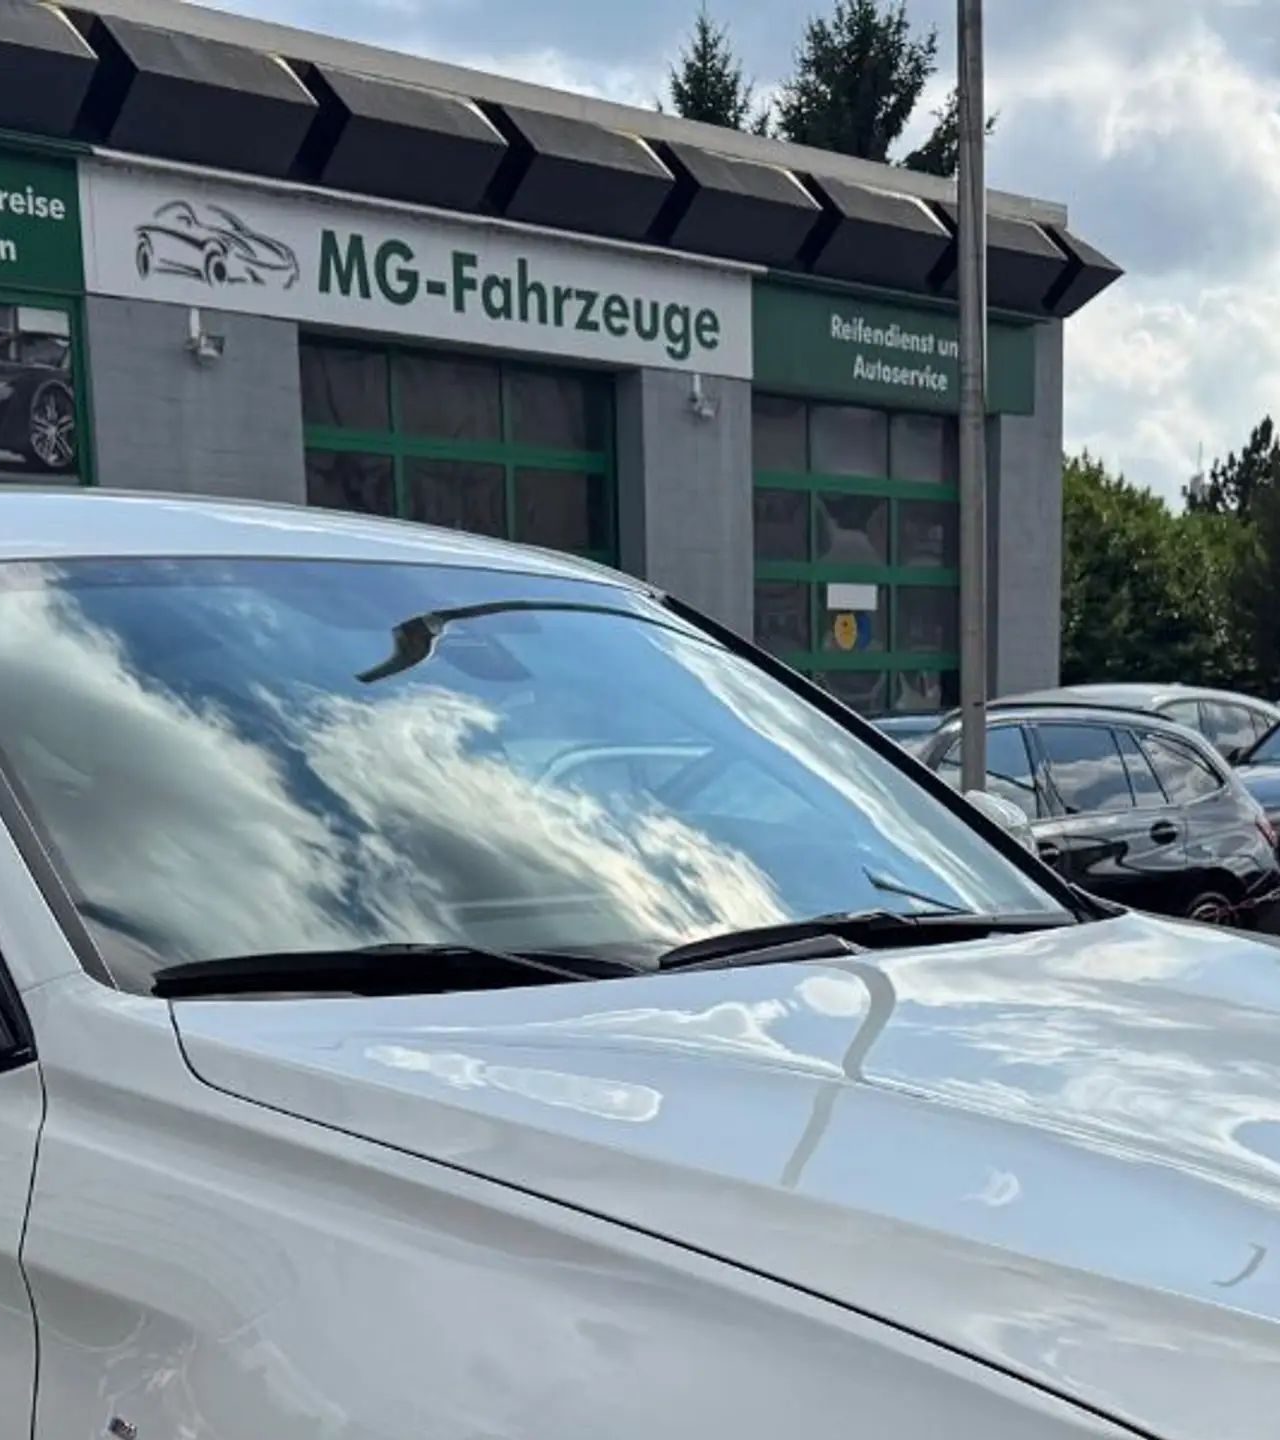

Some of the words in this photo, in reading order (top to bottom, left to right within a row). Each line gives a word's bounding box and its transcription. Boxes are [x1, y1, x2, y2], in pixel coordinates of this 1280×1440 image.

[319, 229, 720, 361] MG-Fahrzeuge
[831, 313, 935, 354] Reifendienst
[853, 353, 948, 391] Autoservice
